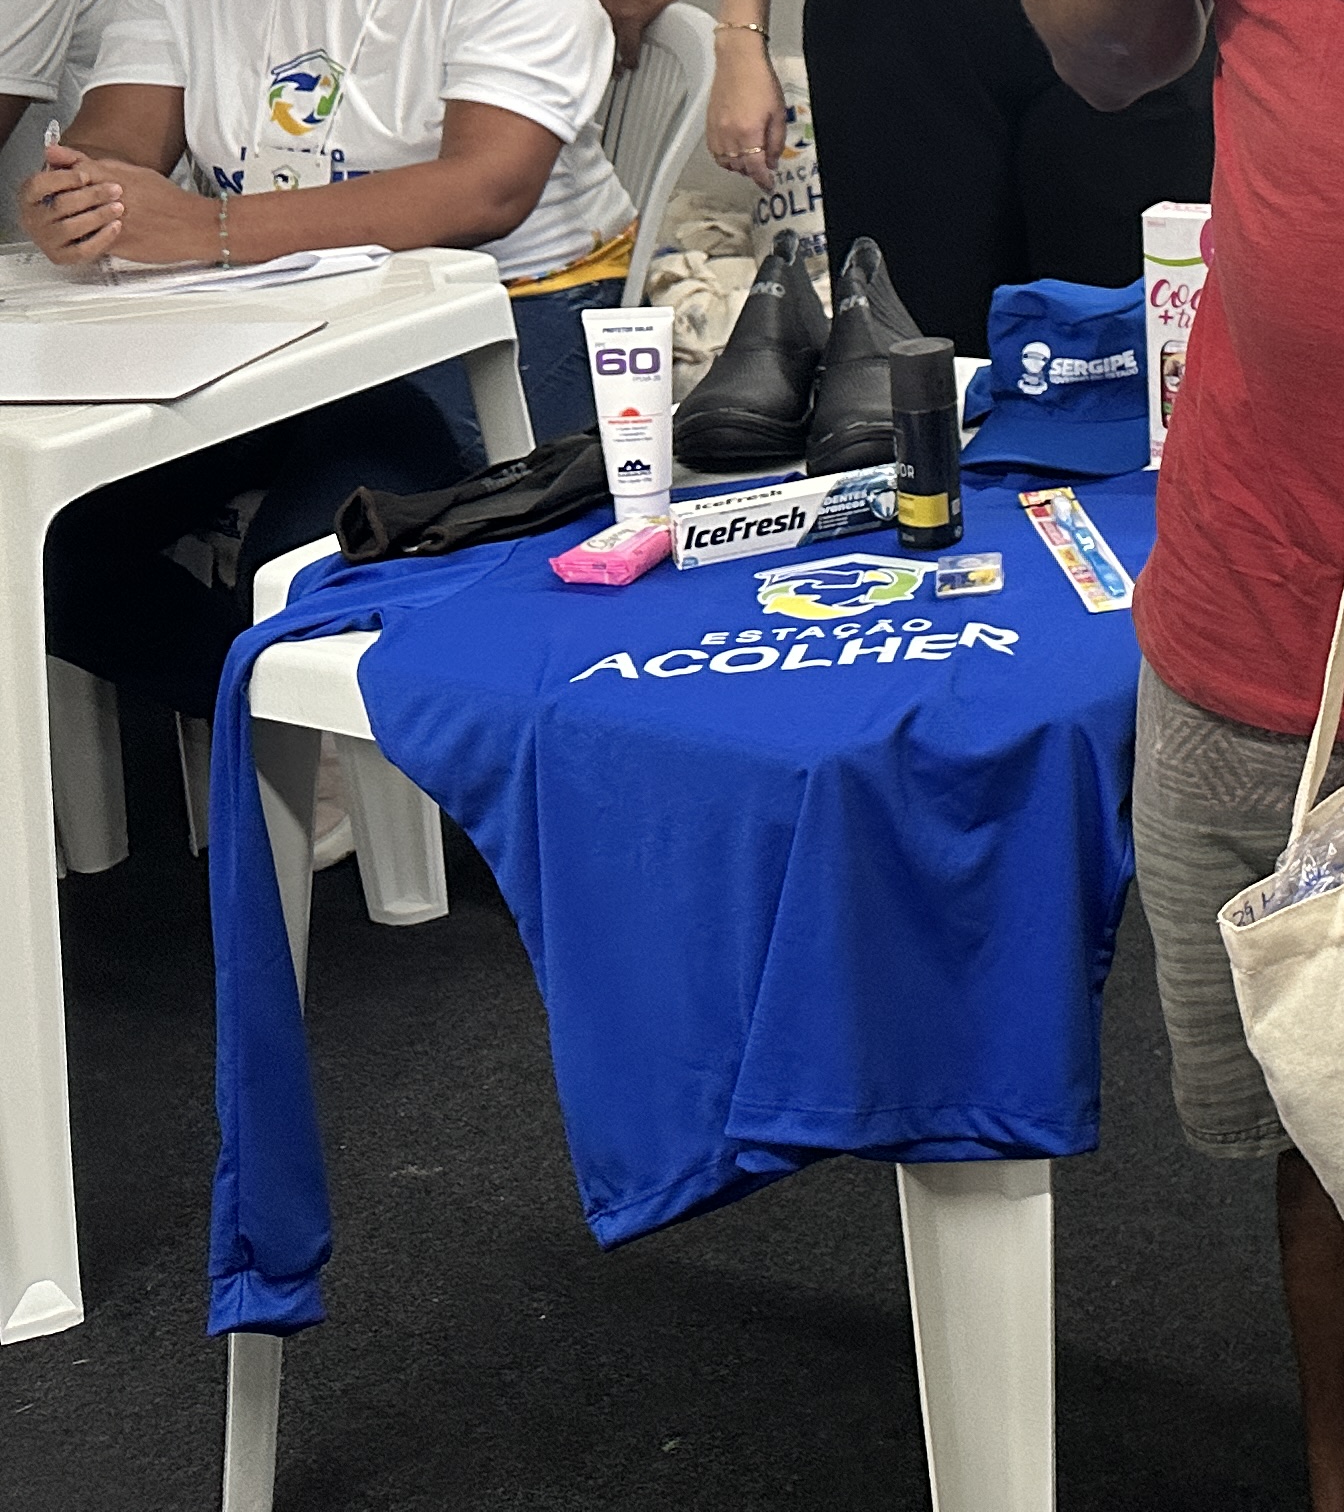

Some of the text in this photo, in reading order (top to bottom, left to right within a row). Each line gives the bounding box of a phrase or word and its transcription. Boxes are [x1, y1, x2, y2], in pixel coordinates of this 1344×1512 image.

[753, 186, 824, 226] COLH
[596, 347, 661, 376] 60
[1050, 349, 1137, 376] SERGIPE
[694, 489, 783, 511] IceFresh
[684, 506, 807, 550] IceFresh
[701, 618, 932, 646] ESTAÇÃO
[569, 621, 1020, 683] ACOLHER
